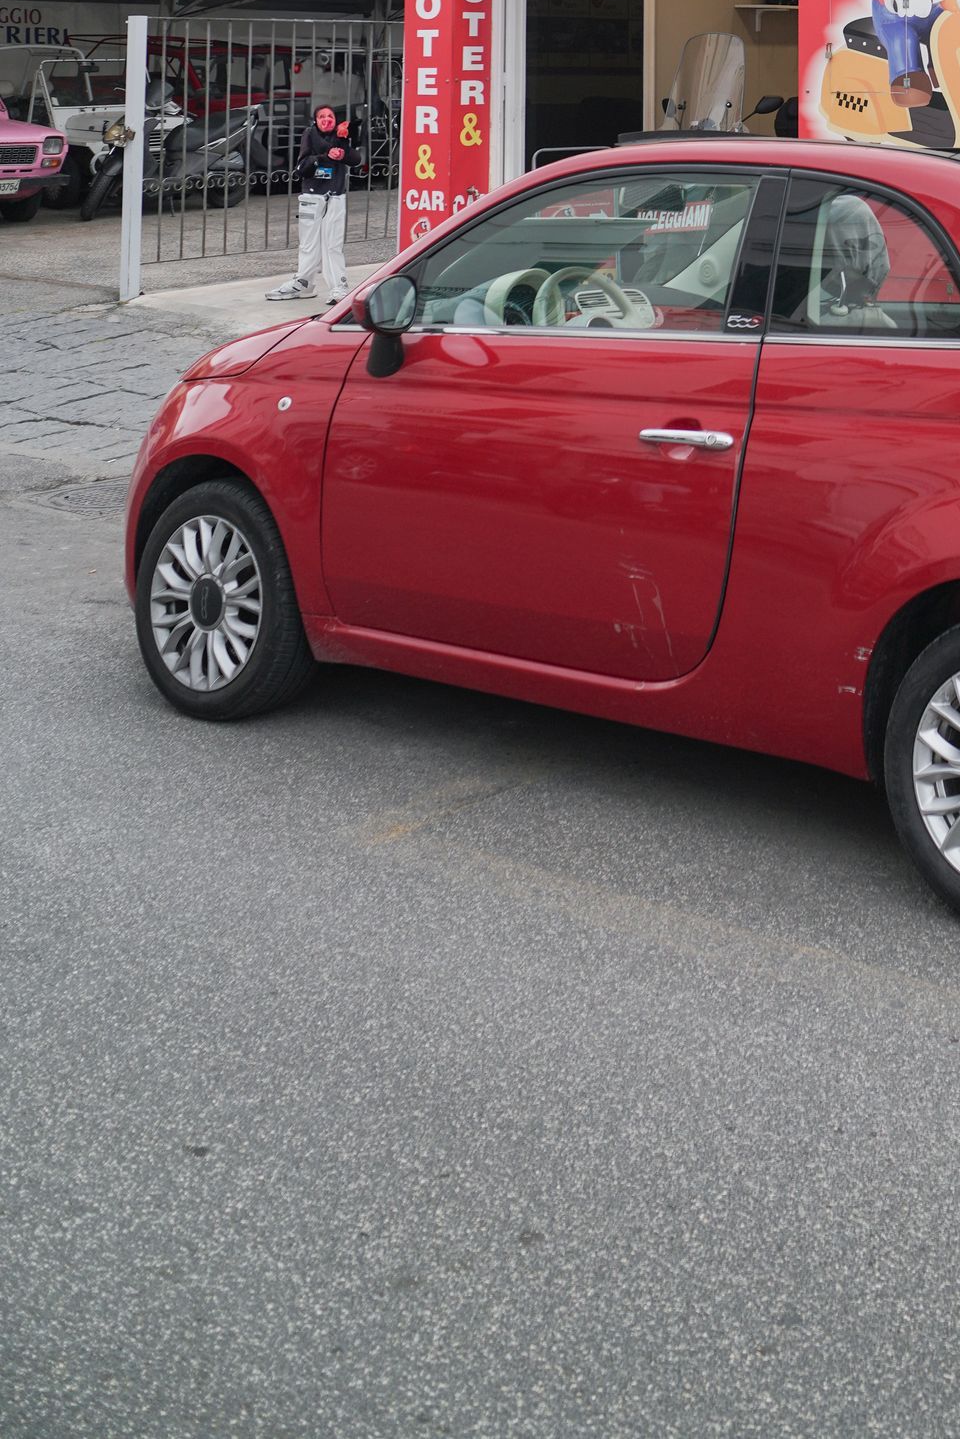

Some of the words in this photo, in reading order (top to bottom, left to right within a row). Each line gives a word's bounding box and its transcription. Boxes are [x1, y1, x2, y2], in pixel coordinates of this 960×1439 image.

[0, 26, 69, 47] RIERI
[460, 113, 483, 147] &
[414, 144, 436, 180] &
[406, 189, 445, 212] CAR
